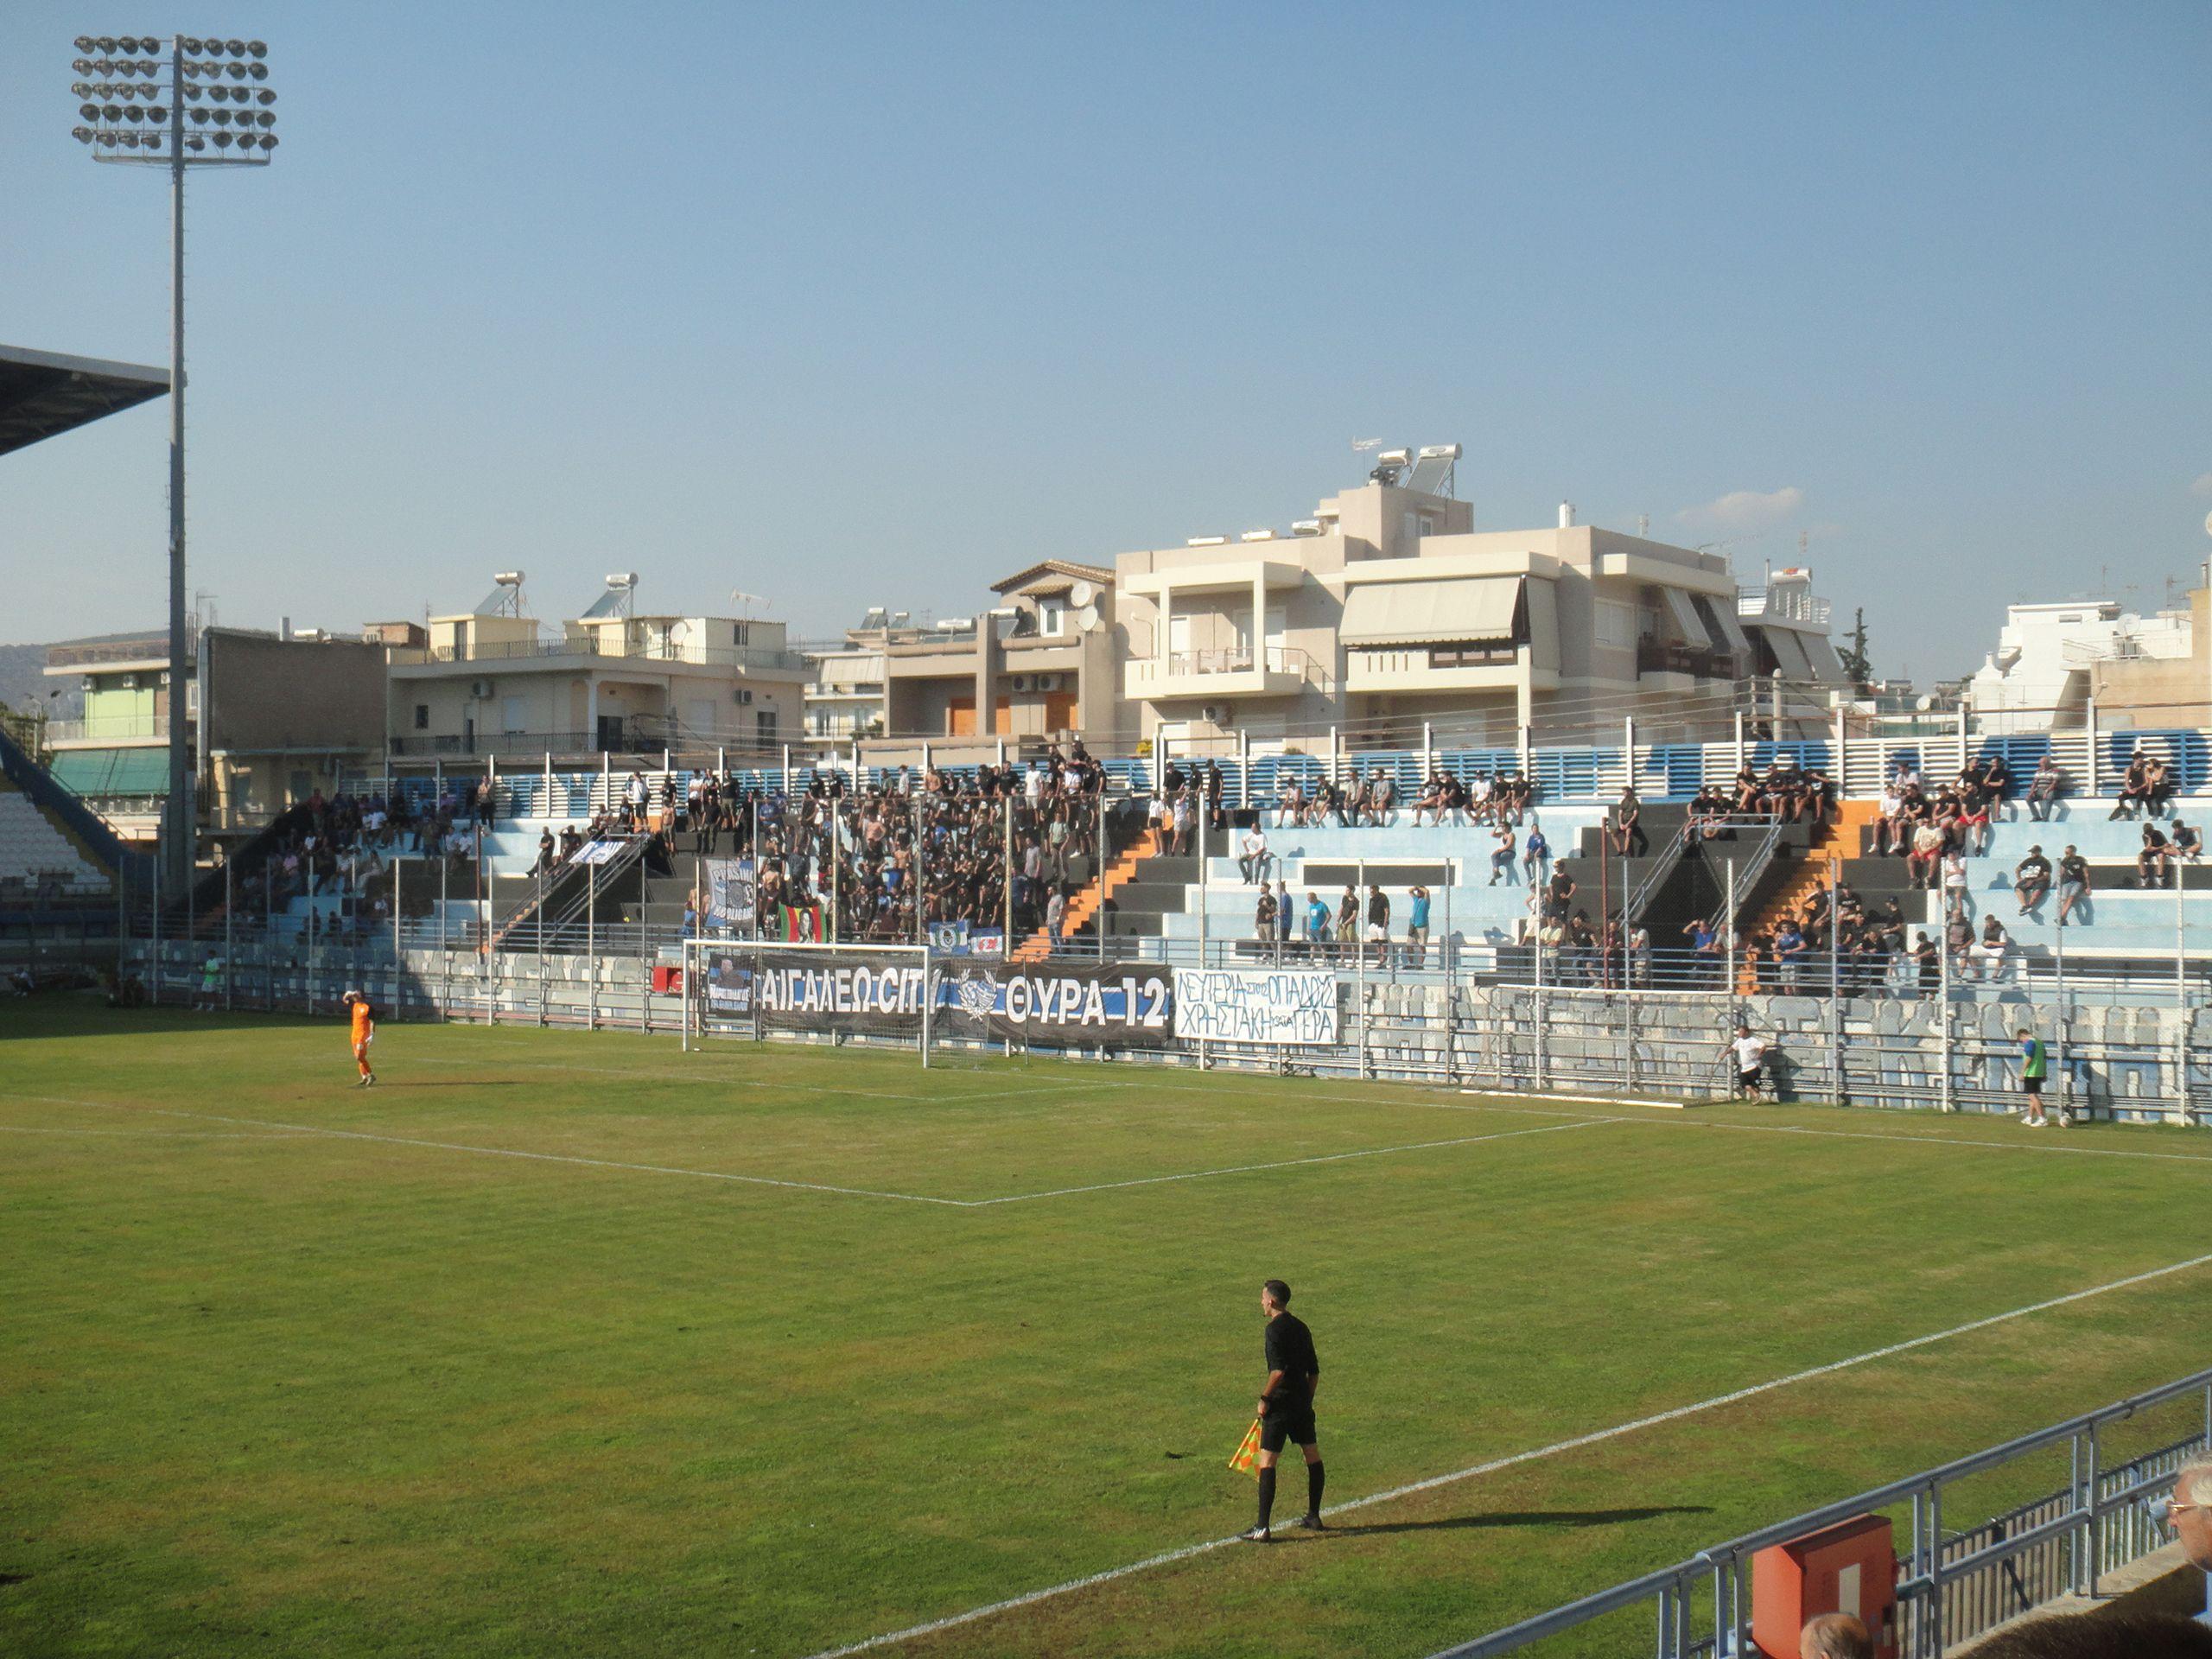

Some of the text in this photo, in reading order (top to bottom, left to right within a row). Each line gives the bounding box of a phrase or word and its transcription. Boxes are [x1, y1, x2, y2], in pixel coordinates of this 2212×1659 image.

[762, 966, 1165, 1027] ΑΙΓΑΛΕΩ CITY ΘΥΡΑ 12
[1268, 975, 1337, 1008] ΟΠΑΔΟΥΣ
[1181, 1003, 1272, 1040] ΧΡΗΣΤΑΚΗ
[1294, 1008, 1336, 1042] ΓΕΡΑ
